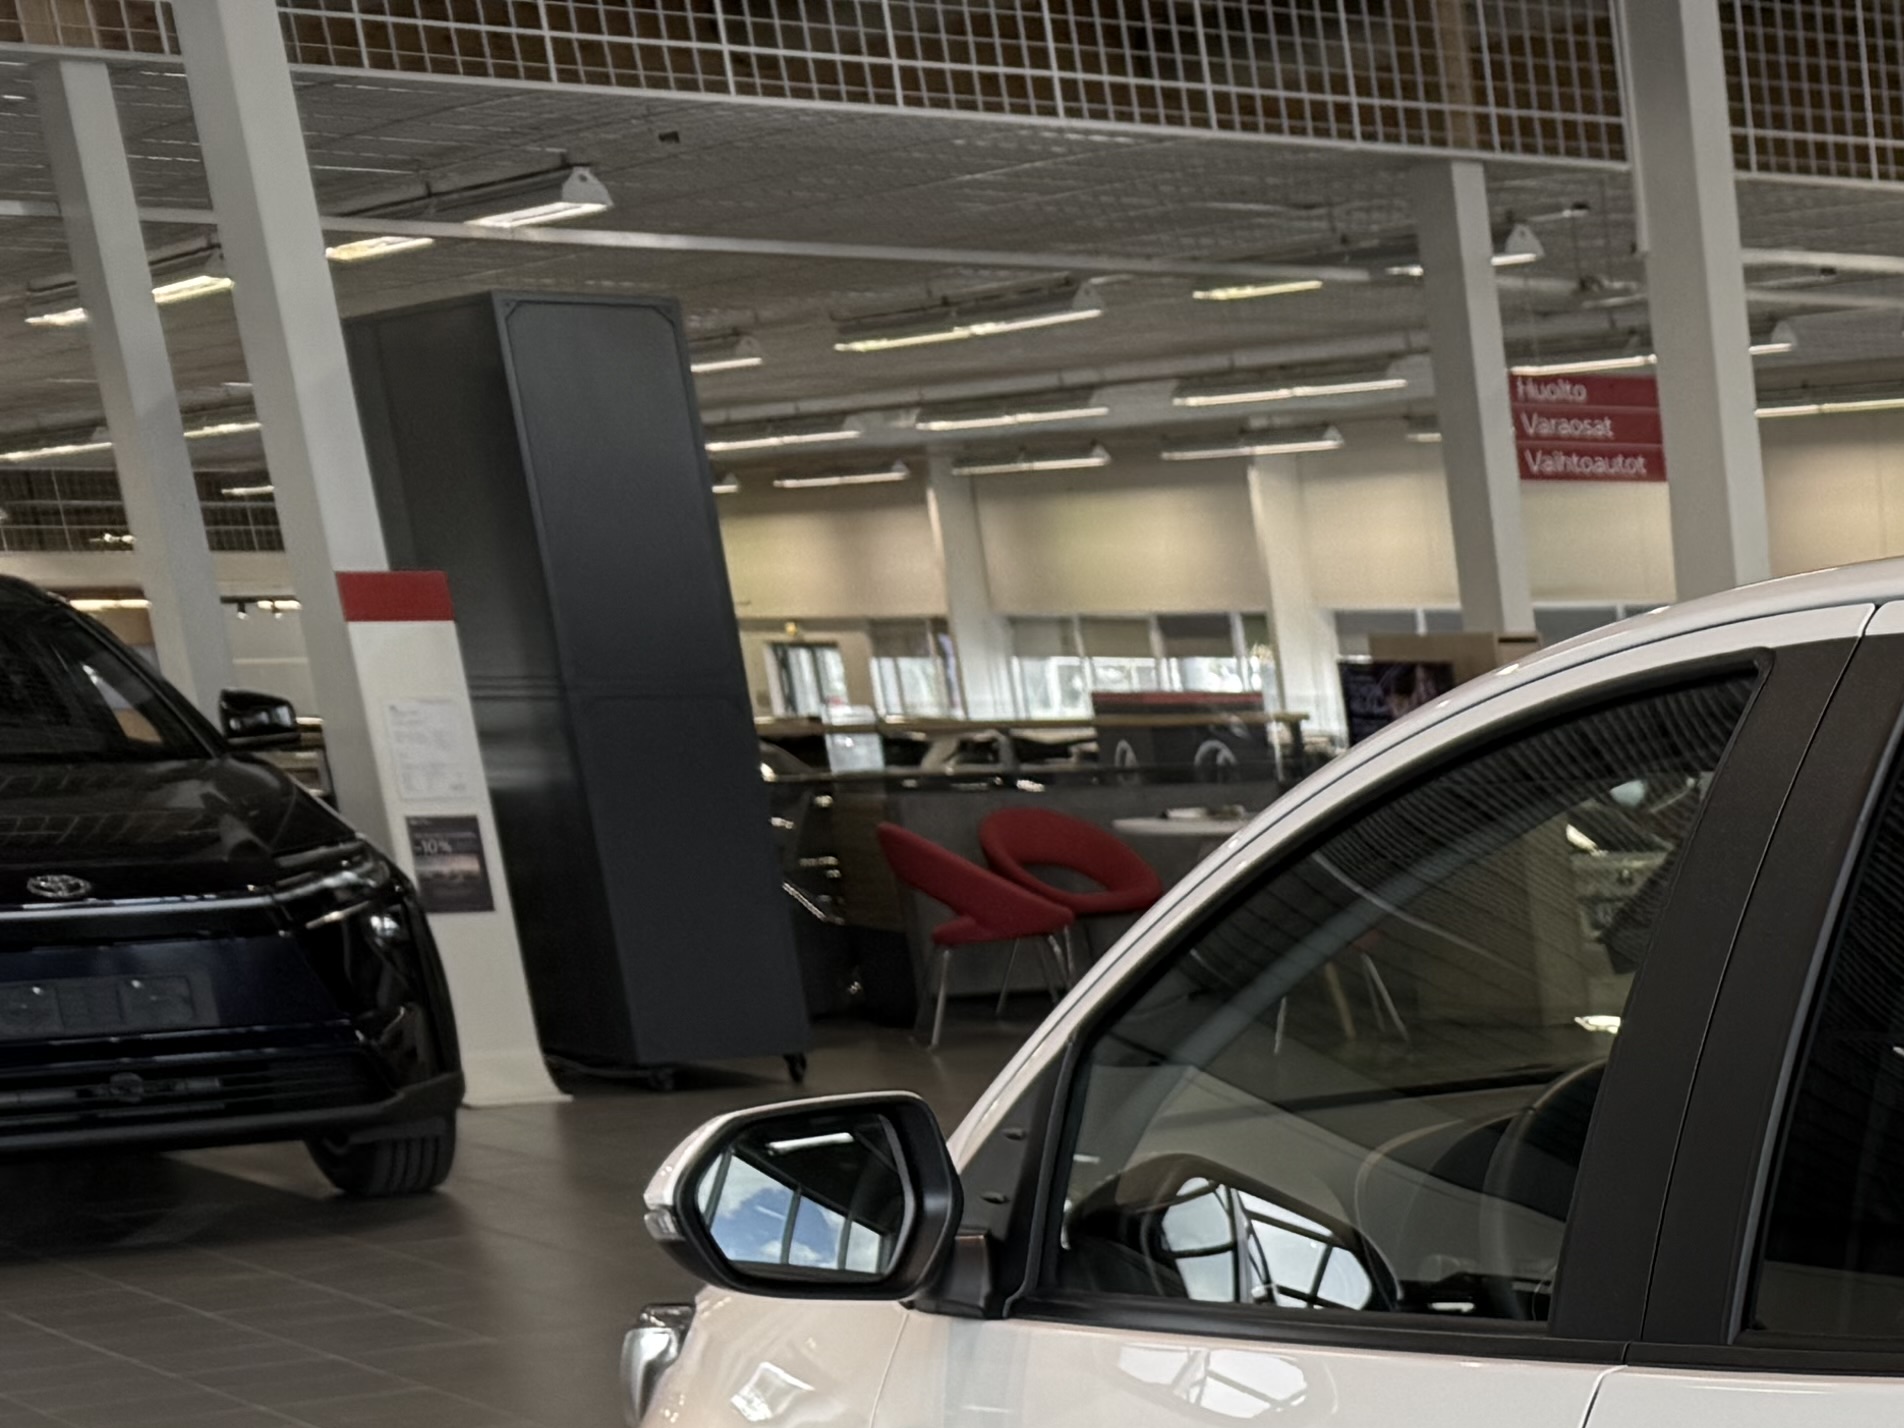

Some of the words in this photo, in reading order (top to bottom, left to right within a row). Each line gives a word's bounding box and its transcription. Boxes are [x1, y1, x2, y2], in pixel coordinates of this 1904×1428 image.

[1516, 377, 1588, 403] Huolto
[1520, 411, 1614, 439] Varaosat
[1523, 449, 1647, 477] Vaihtoautot
